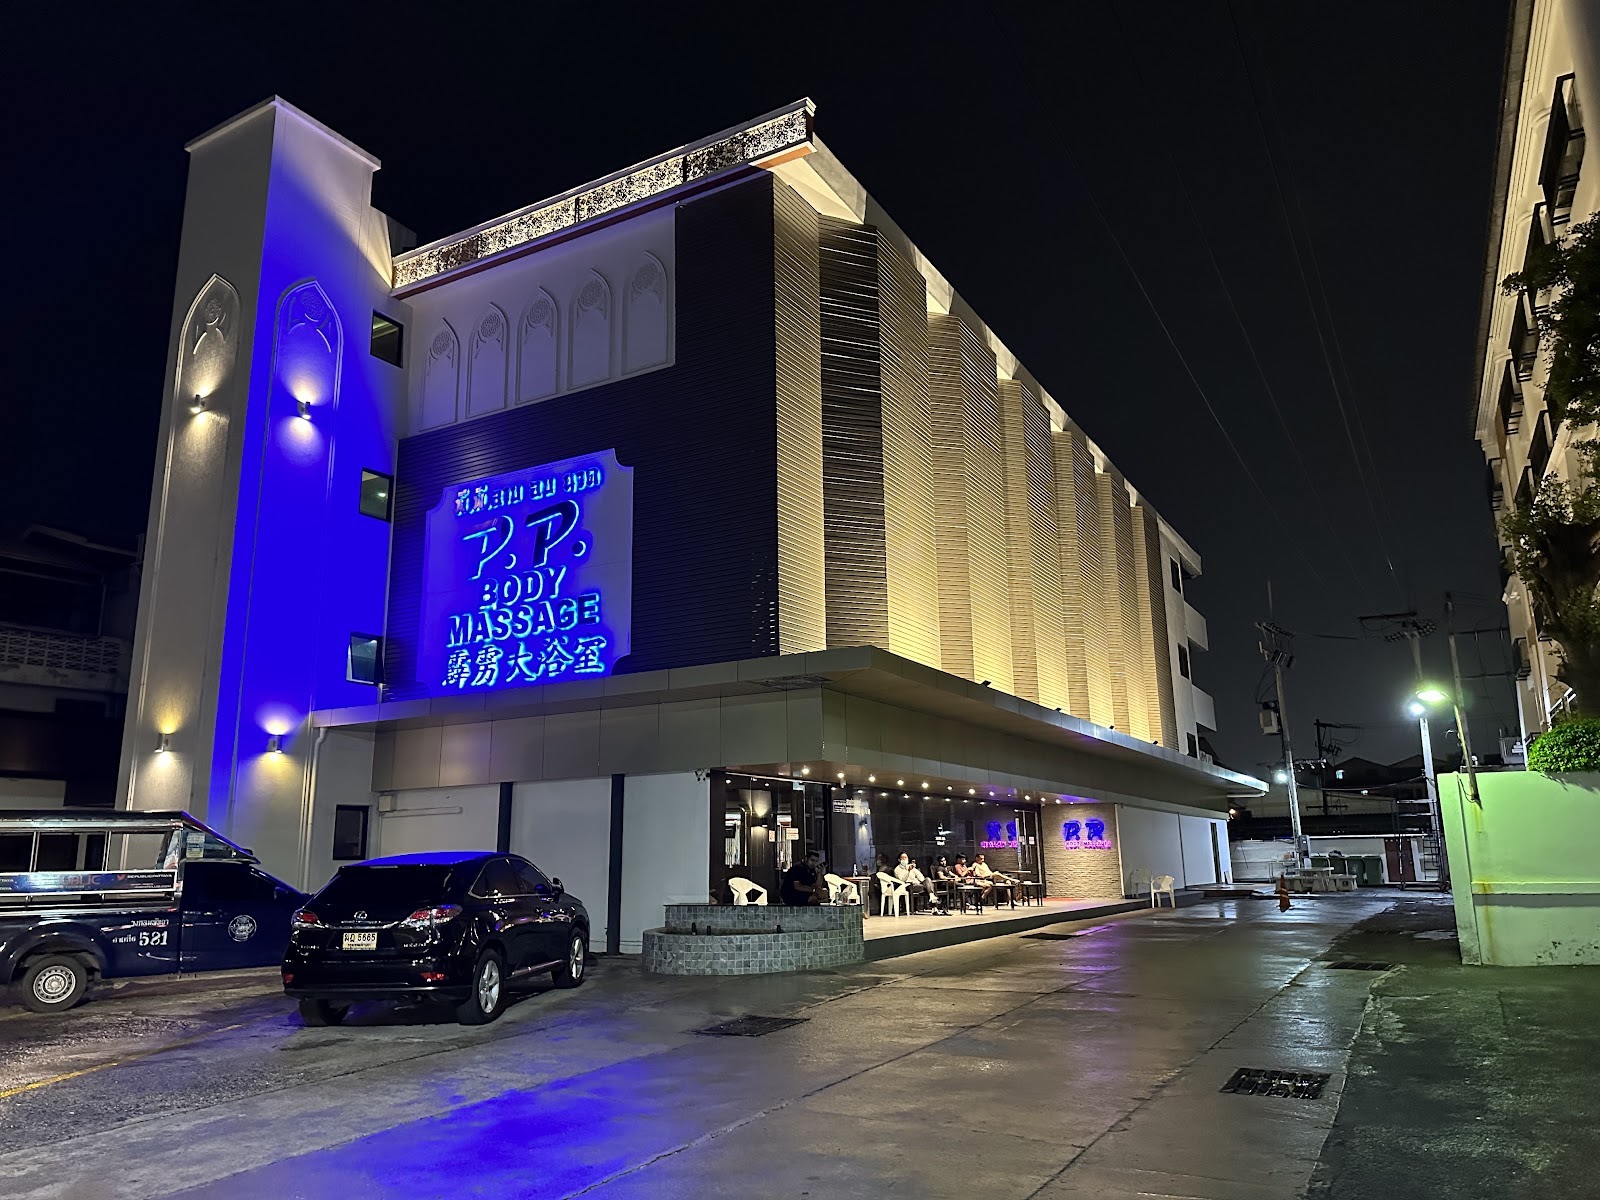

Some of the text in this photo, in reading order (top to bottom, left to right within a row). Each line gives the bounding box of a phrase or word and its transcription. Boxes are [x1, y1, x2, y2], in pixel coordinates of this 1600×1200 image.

[480, 565, 567, 611] BODY
[446, 592, 601, 648] MASSAGE
[138, 930, 168, 946] 581
[357, 933, 376, 942] 5665
